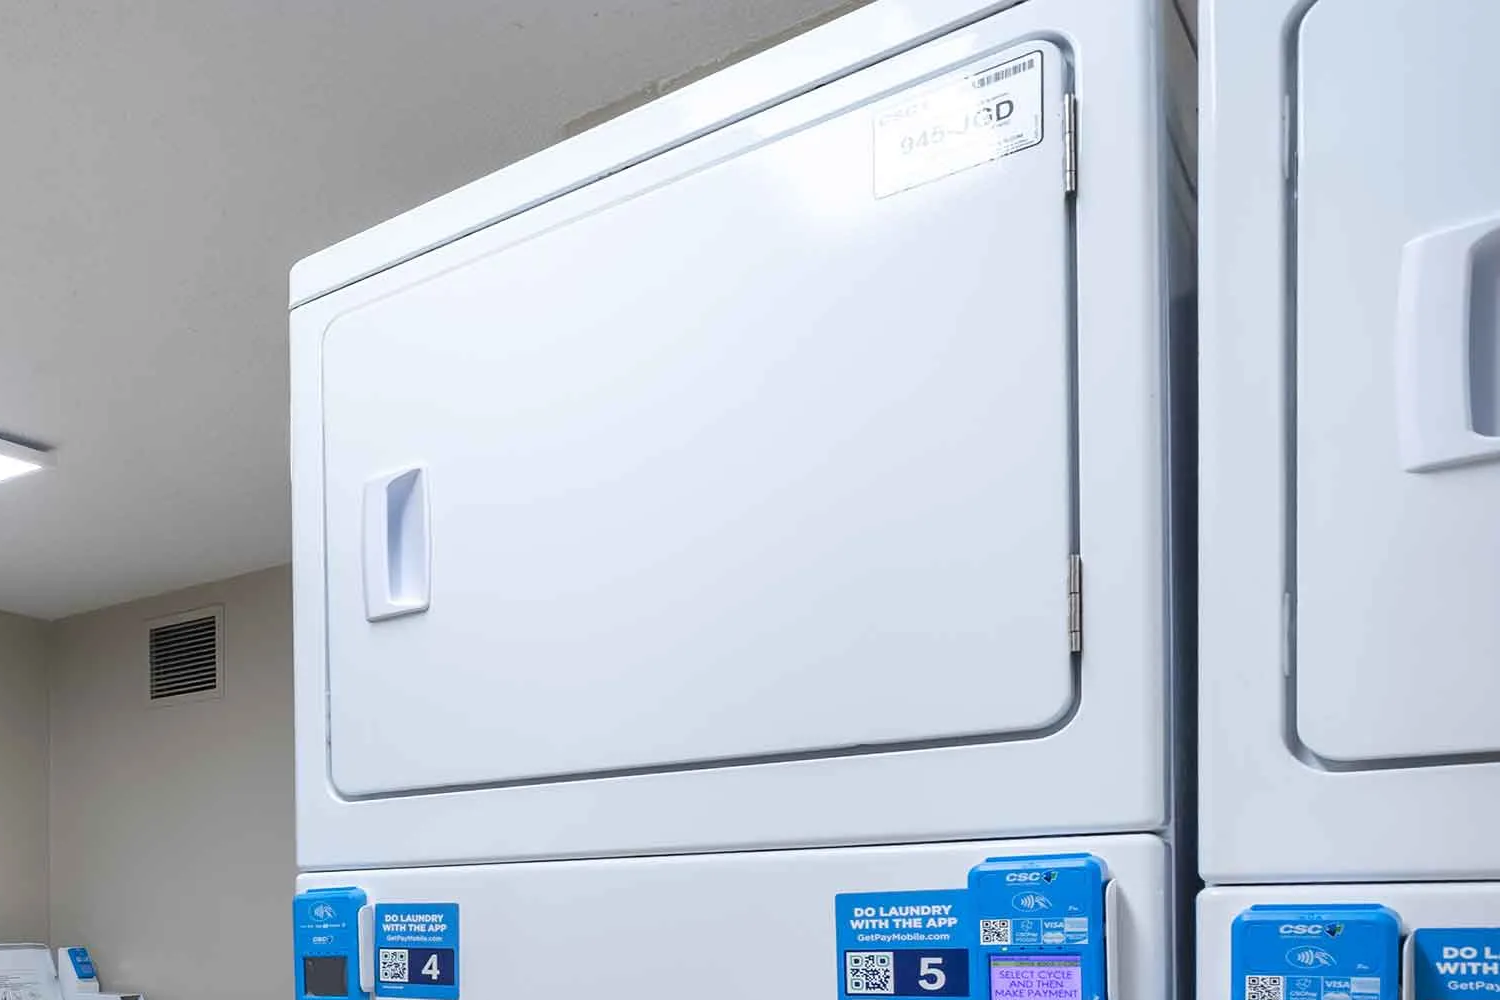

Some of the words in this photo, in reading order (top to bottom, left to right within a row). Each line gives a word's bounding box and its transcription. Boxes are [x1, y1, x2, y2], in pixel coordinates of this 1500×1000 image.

[1006, 871, 1041, 882] CSC
[853, 907, 876, 917] DO
[879, 904, 952, 917] LAUNDRY
[384, 914, 398, 923] DO
[400, 914, 444, 923] LAUNDRY
[850, 919, 889, 930] WITH
[892, 918, 922, 929] THE
[925, 917, 958, 928] APP
[382, 923, 407, 933] WITH
[409, 923, 426, 933] THE
[428, 923, 447, 933] APP
[1043, 921, 1065, 929] VISA
[1278, 923, 1323, 935] CSC
[857, 932, 950, 943] GetPayMobile.com
[1443, 946, 1477, 960] DO
[421, 953, 441, 981] 4
[1435, 961, 1499, 976] WITH
[917, 956, 946, 991] 5
[999, 970, 1034, 980] SELECT
[1037, 970, 1073, 980] CYCLE
[1009, 980, 1034, 989] AND
[1036, 980, 1064, 989] THEN
[1325, 980, 1350, 989] VISA
[994, 989, 1025, 998] MAKE
[1027, 989, 1078, 998] PAYMENT
